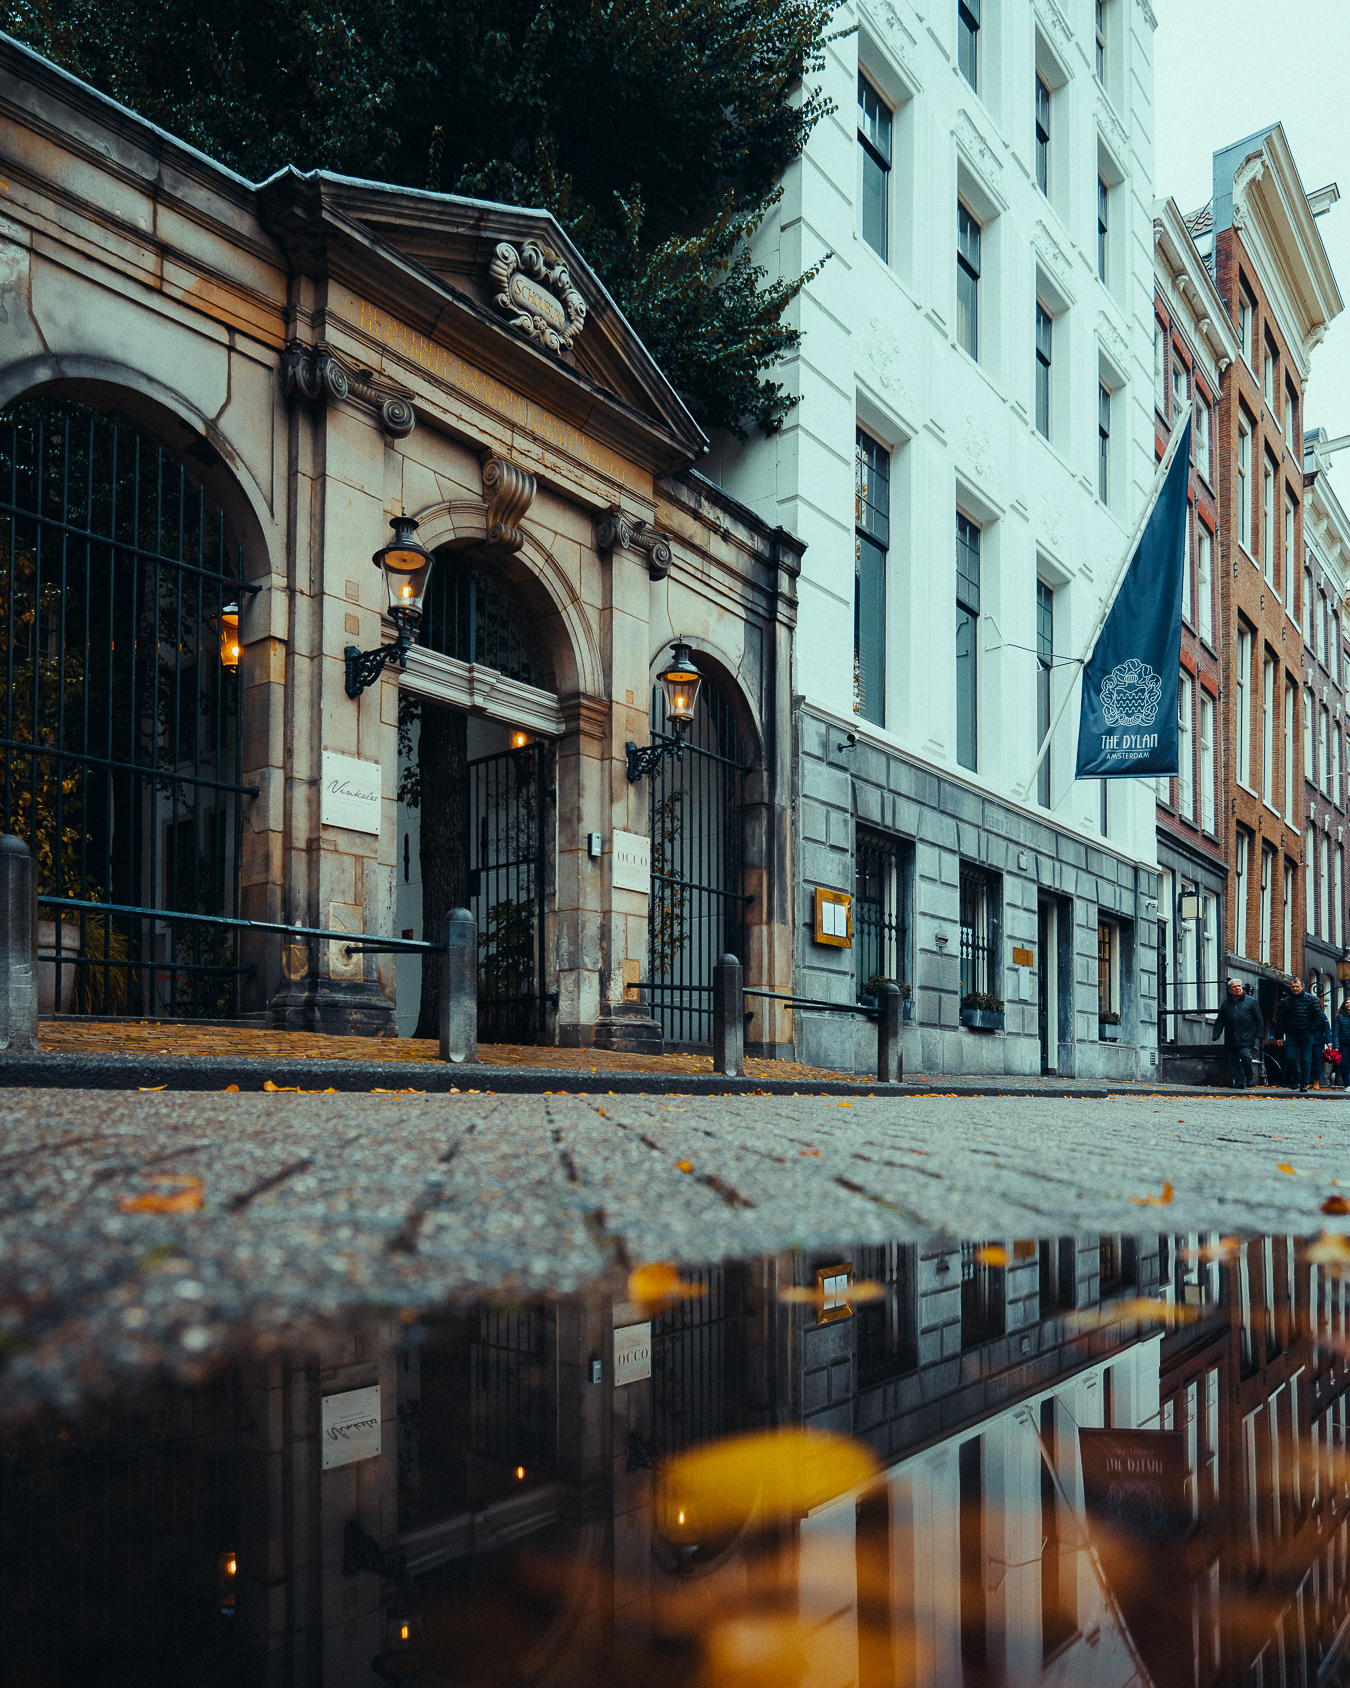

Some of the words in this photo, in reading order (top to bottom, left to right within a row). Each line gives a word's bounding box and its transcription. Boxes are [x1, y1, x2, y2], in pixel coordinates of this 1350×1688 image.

[361, 302, 380, 323] DE
[387, 317, 453, 366] WEERELD
[458, 361, 470, 377] IS
[475, 371, 498, 394] EEN
[360, 315, 396, 346] ELCK
[402, 341, 450, 377] SPEELT
[455, 372, 480, 396] ZYN
[485, 390, 508, 413] ROL
[512, 406, 527, 424] EN
[531, 418, 575, 450] KRYGHT
[579, 446, 599, 466] ZYN
[602, 460, 627, 482] DEEL
[1101, 735, 1120, 750] THE
[1122, 733, 1158, 749] DYLAN
[1105, 751, 1150, 760] AMSTERDAM
[326, 779, 378, 802] Vinkeles
[617, 850, 648, 867] OCCO
